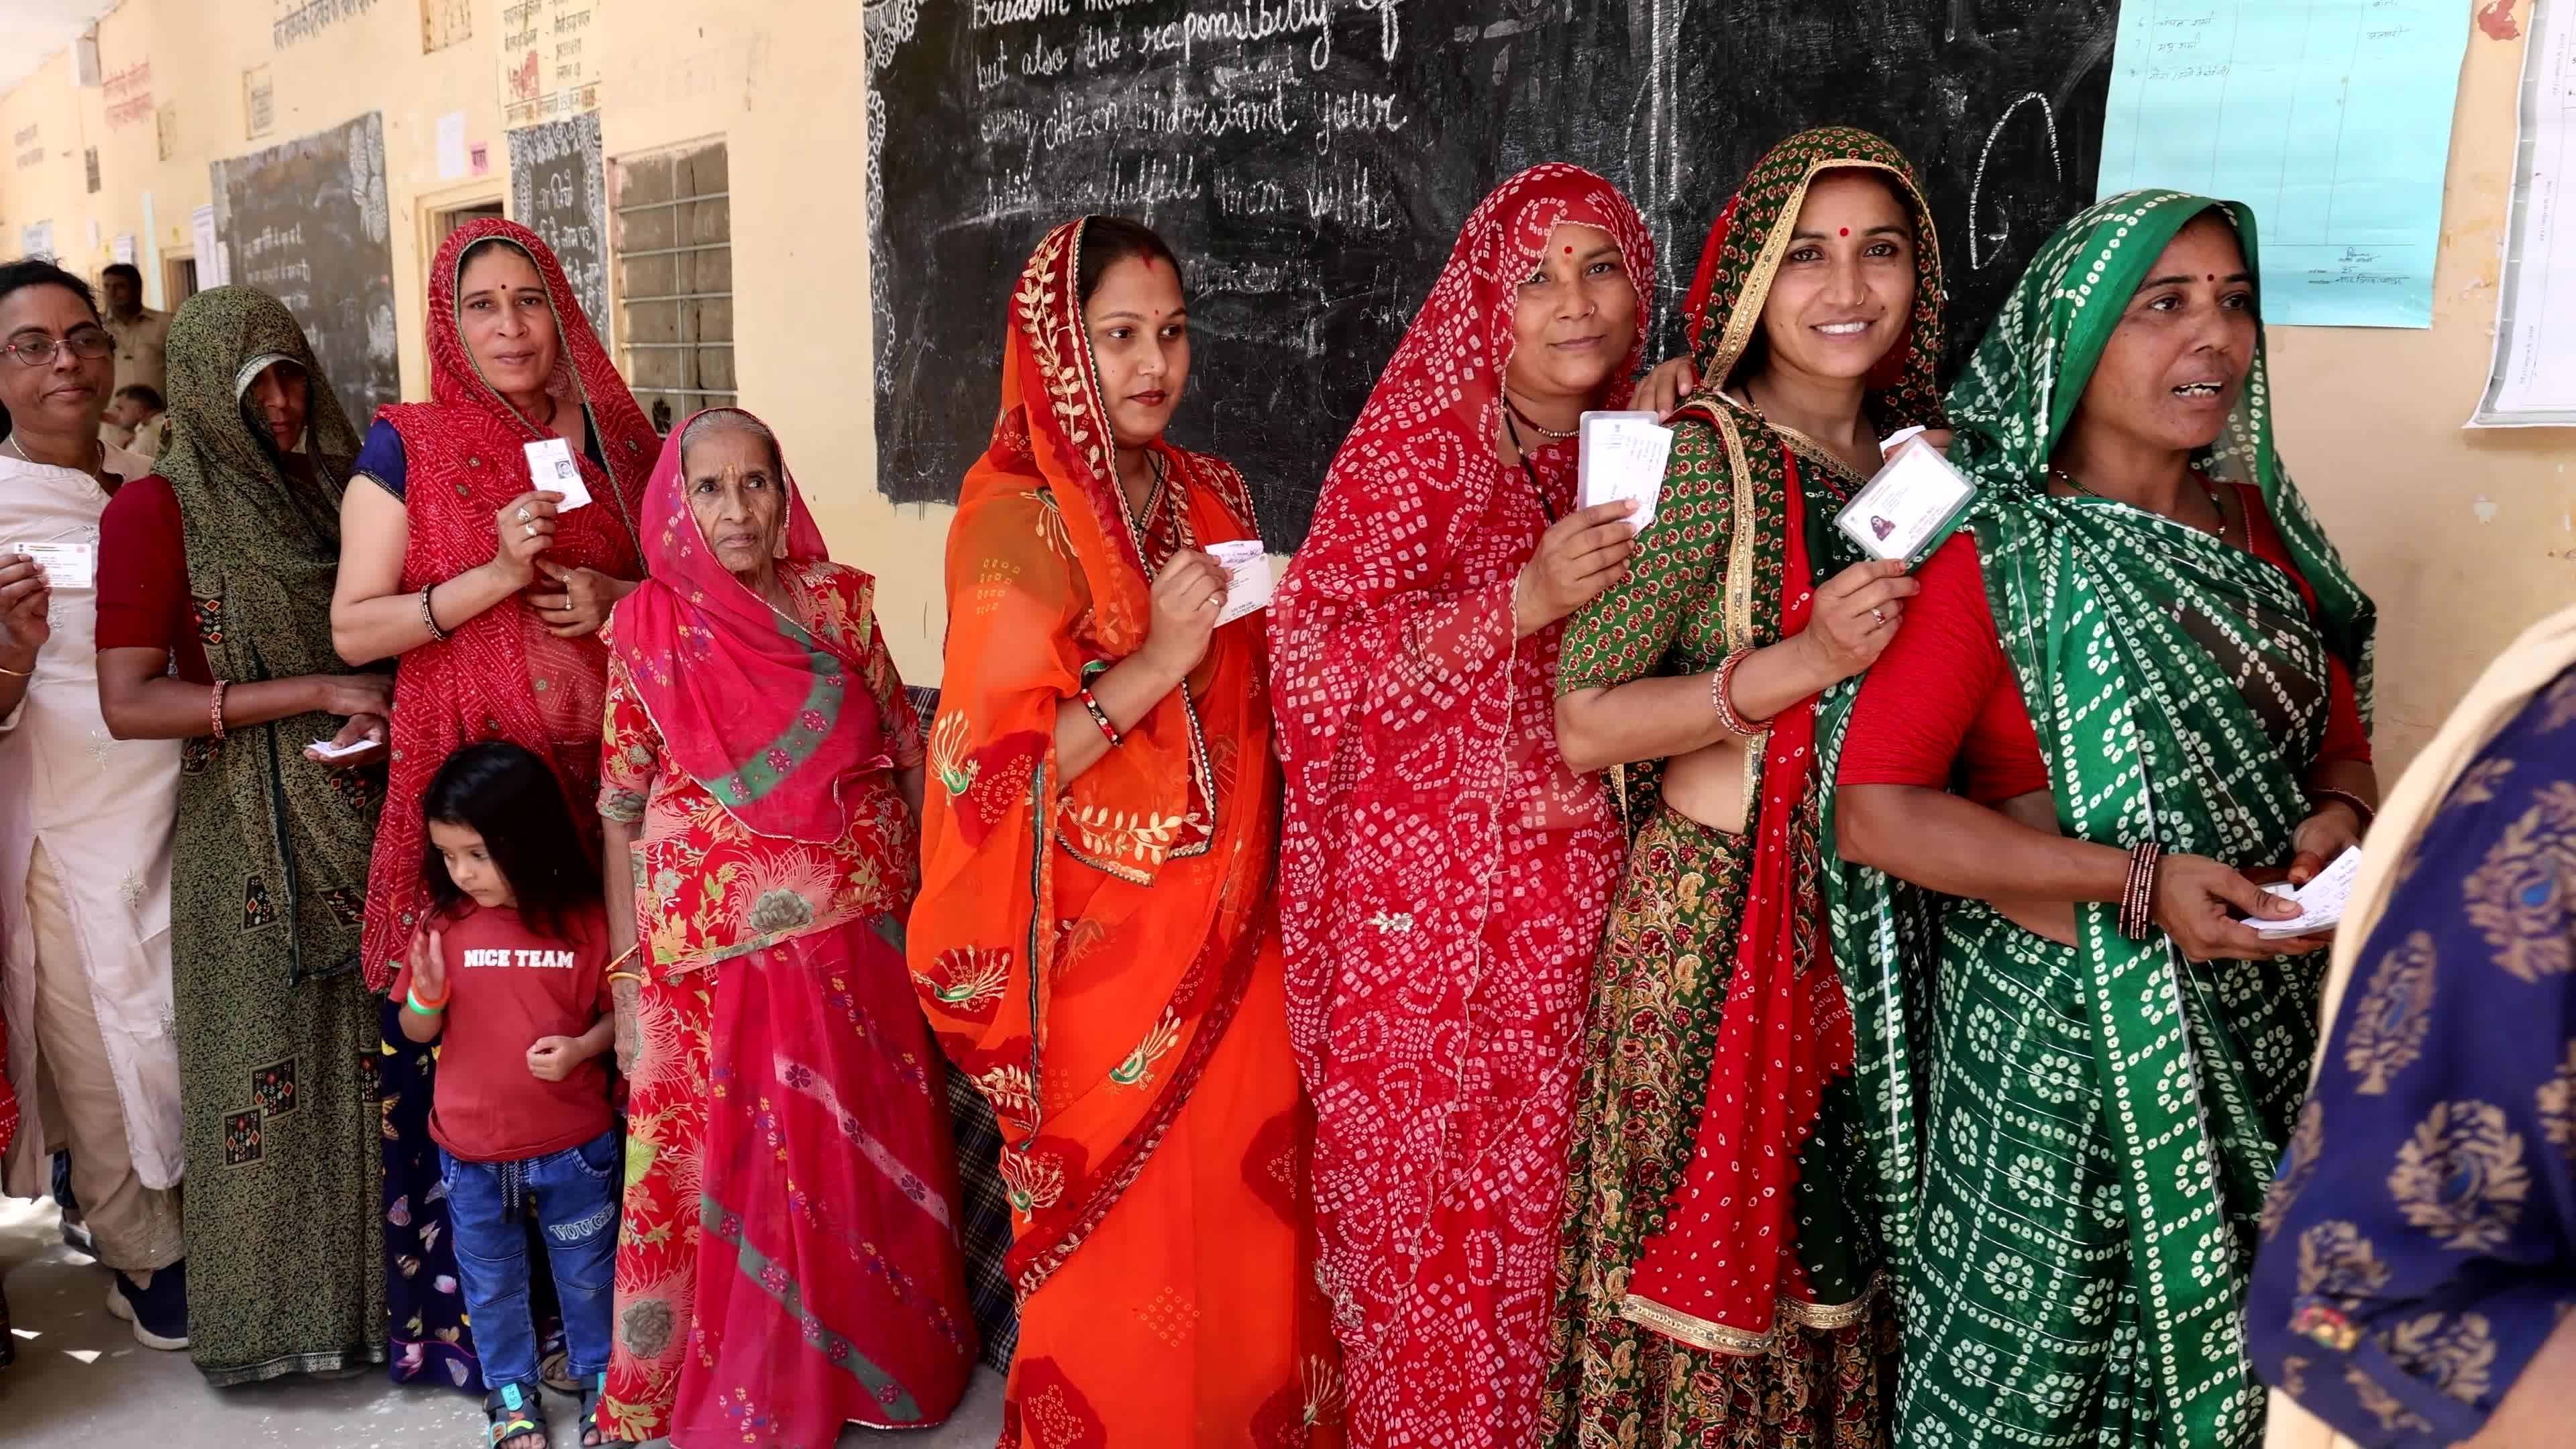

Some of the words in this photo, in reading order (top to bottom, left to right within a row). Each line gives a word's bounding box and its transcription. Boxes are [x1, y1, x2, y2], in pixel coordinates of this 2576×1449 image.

[977, 39, 1008, 91] but
[1022, 34, 1068, 75] also
[1083, 25, 1122, 68] the
[1313, 90, 1407, 155] your
[464, 949, 511, 967] NICE
[515, 950, 575, 969] TEAM
